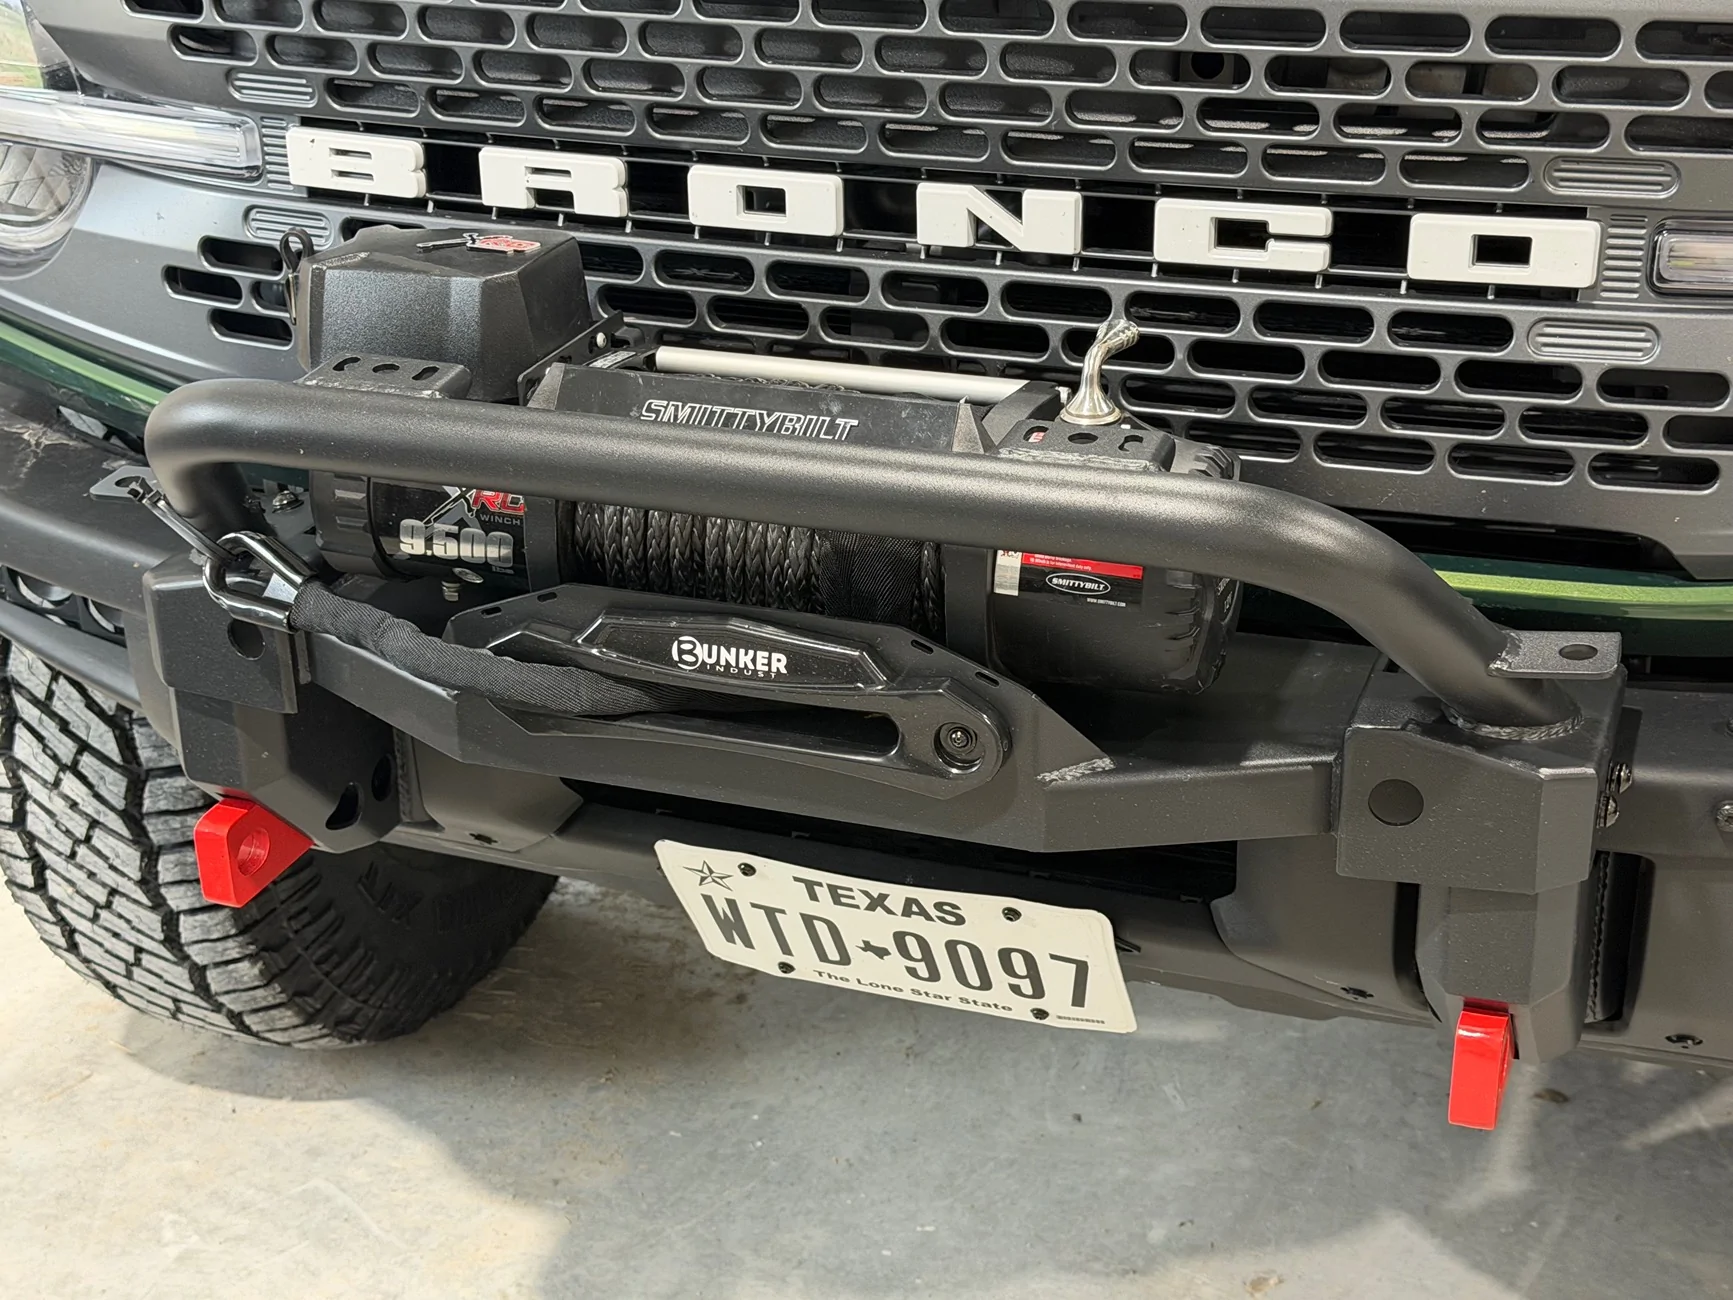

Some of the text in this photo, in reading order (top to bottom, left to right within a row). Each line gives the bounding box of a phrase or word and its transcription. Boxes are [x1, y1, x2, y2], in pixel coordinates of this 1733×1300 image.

[286, 127, 1602, 289] BRONCO
[640, 399, 859, 441] SMITTYBILT
[479, 513, 521, 526] WINCH
[1051, 577, 1105, 592] SMITTYBILT
[671, 635, 788, 674] BUNKER
[706, 664, 777, 679] INDUST
[793, 876, 966, 926] TEXAS
[701, 893, 1089, 1008] WTD 9097
[813, 969, 1013, 1012] The Lone Star State
